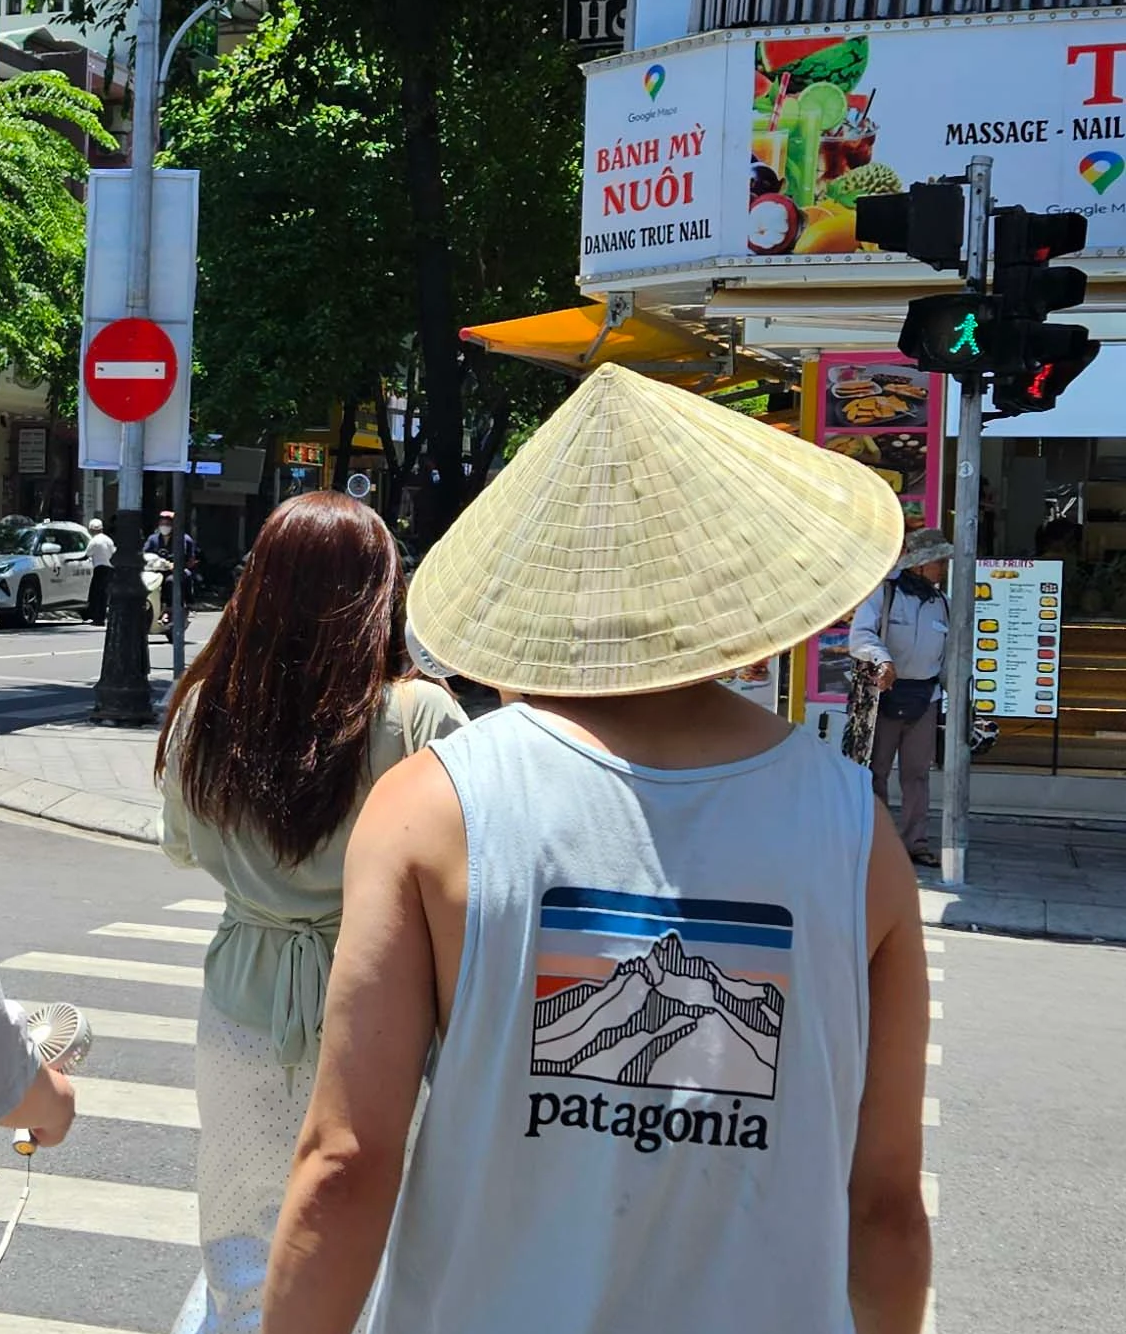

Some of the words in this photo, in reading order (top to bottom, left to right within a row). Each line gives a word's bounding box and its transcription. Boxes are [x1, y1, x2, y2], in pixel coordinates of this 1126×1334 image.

[628, 108, 656, 123] Google
[945, 119, 1049, 146] MASSAGE
[1072, 116, 1126, 141] NAIL
[596, 137, 660, 173] BÁNH
[669, 123, 706, 161] MỲ
[603, 166, 694, 217] NUÔI
[1046, 203, 1107, 217] Google
[584, 229, 636, 255] DANANG
[640, 223, 675, 247] TRUE
[679, 218, 712, 242] NAIL
[978, 559, 1001, 568] TRUE
[1003, 559, 1034, 568] FRUITS
[524, 1091, 769, 1154] patagonia
